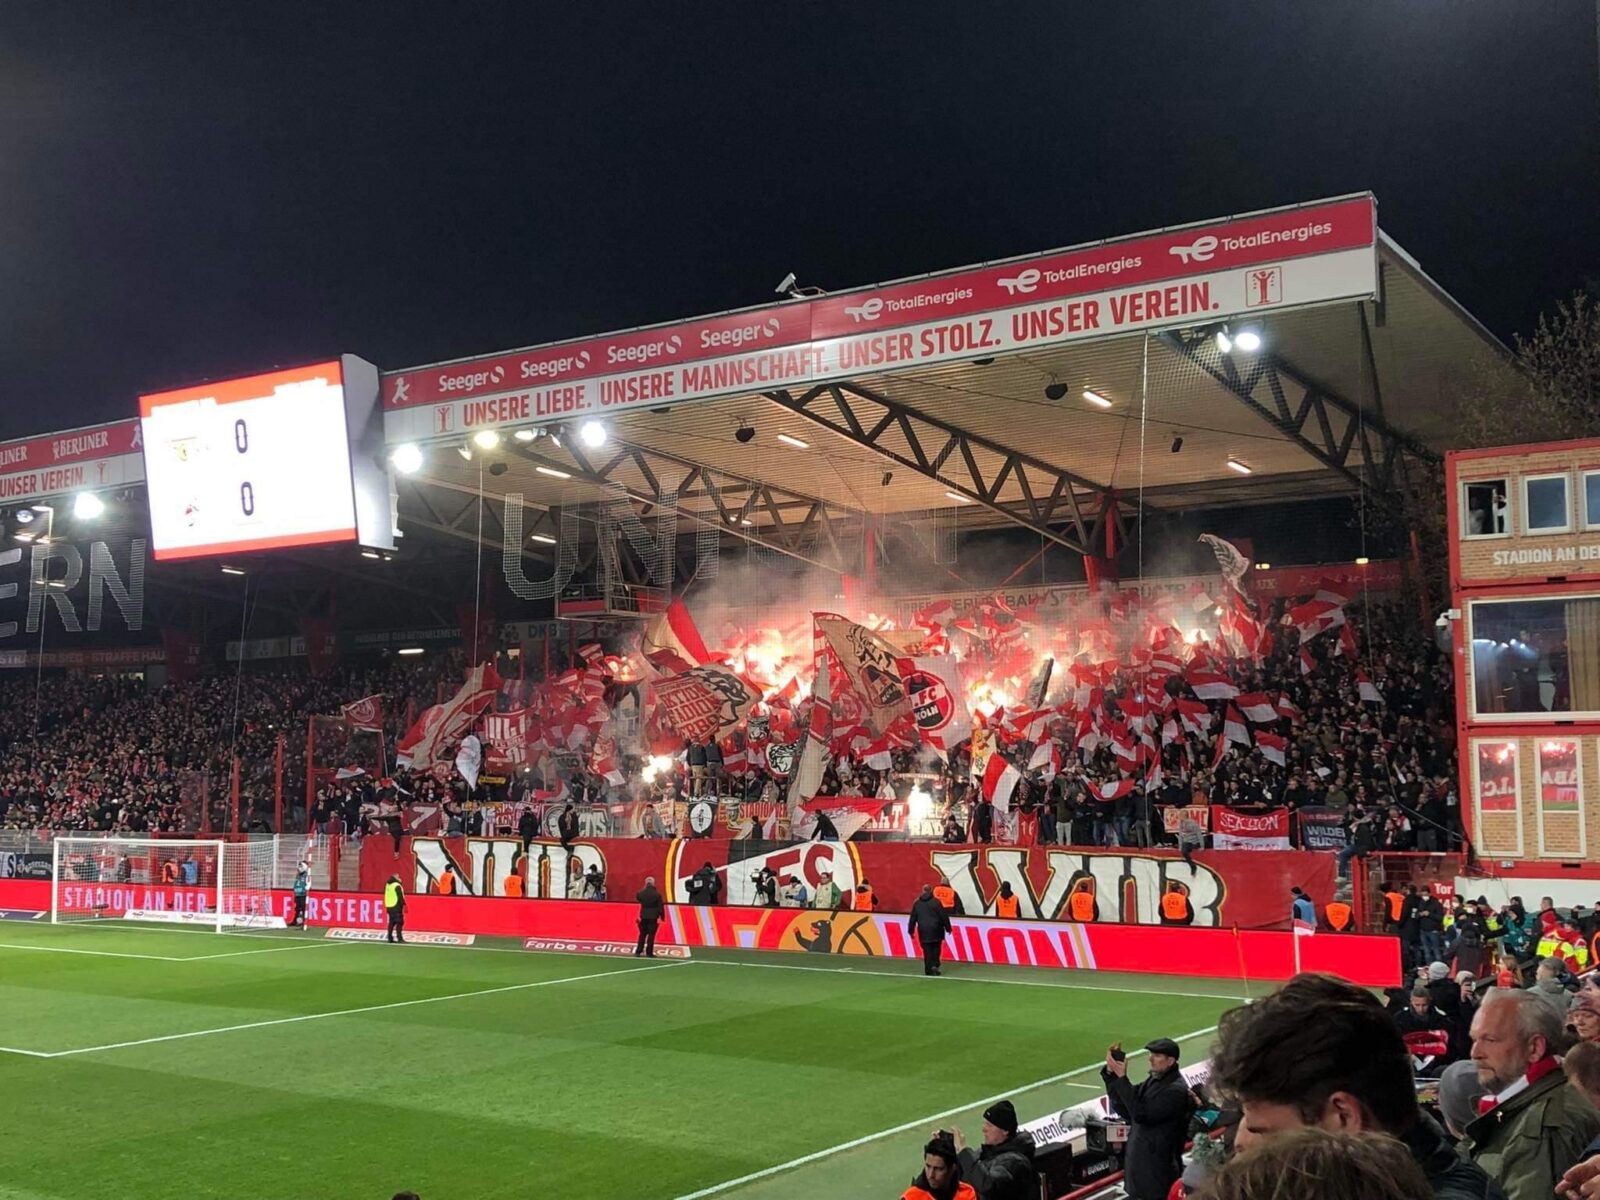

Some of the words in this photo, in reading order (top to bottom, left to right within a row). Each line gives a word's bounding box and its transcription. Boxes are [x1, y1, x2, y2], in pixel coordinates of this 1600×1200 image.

[1221, 221, 1332, 252] TotalEnergies
[1043, 254, 1142, 284] TotalEnergies
[885, 287, 973, 312] TotalEnergies
[700, 324, 761, 349] Seeger
[463, 394, 530, 427] UNSERE
[536, 385, 592, 416] LIEBE.
[600, 371, 674, 405] UNSERE
[682, 347, 829, 393] MANNSCHAFT.
[838, 339, 914, 369] UNSER
[920, 319, 1002, 357] STOLZ.
[1012, 300, 1100, 342] UNSER
[1109, 281, 1220, 326] VEREIN.
[607, 341, 664, 364] Seeger
[520, 355, 573, 378] Seeger
[438, 371, 489, 392] Seeger
[58, 430, 109, 456] BERLINER
[235, 418, 248, 453] 0
[0, 445, 28, 467] LINER
[0, 474, 37, 497] UNSER
[41, 466, 86, 491] VEREIN.
[240, 481, 254, 516] 0
[1493, 548, 1552, 566] STADION
[1555, 546, 1576, 561] AN
[1579, 544, 1600, 560] DE
[1433, 882, 1453, 895] Tor
[64, 887, 134, 911] STADION
[143, 890, 165, 911] AN
[172, 892, 206, 914] DER
[222, 894, 273, 916] LTEN
[283, 896, 384, 923] FRSTERE
[333, 929, 459, 943] kfzteil24.de
[525, 940, 577, 951] Farbe
[594, 943, 682, 956] dire.de
[1032, 1117, 1074, 1143] ngenie
